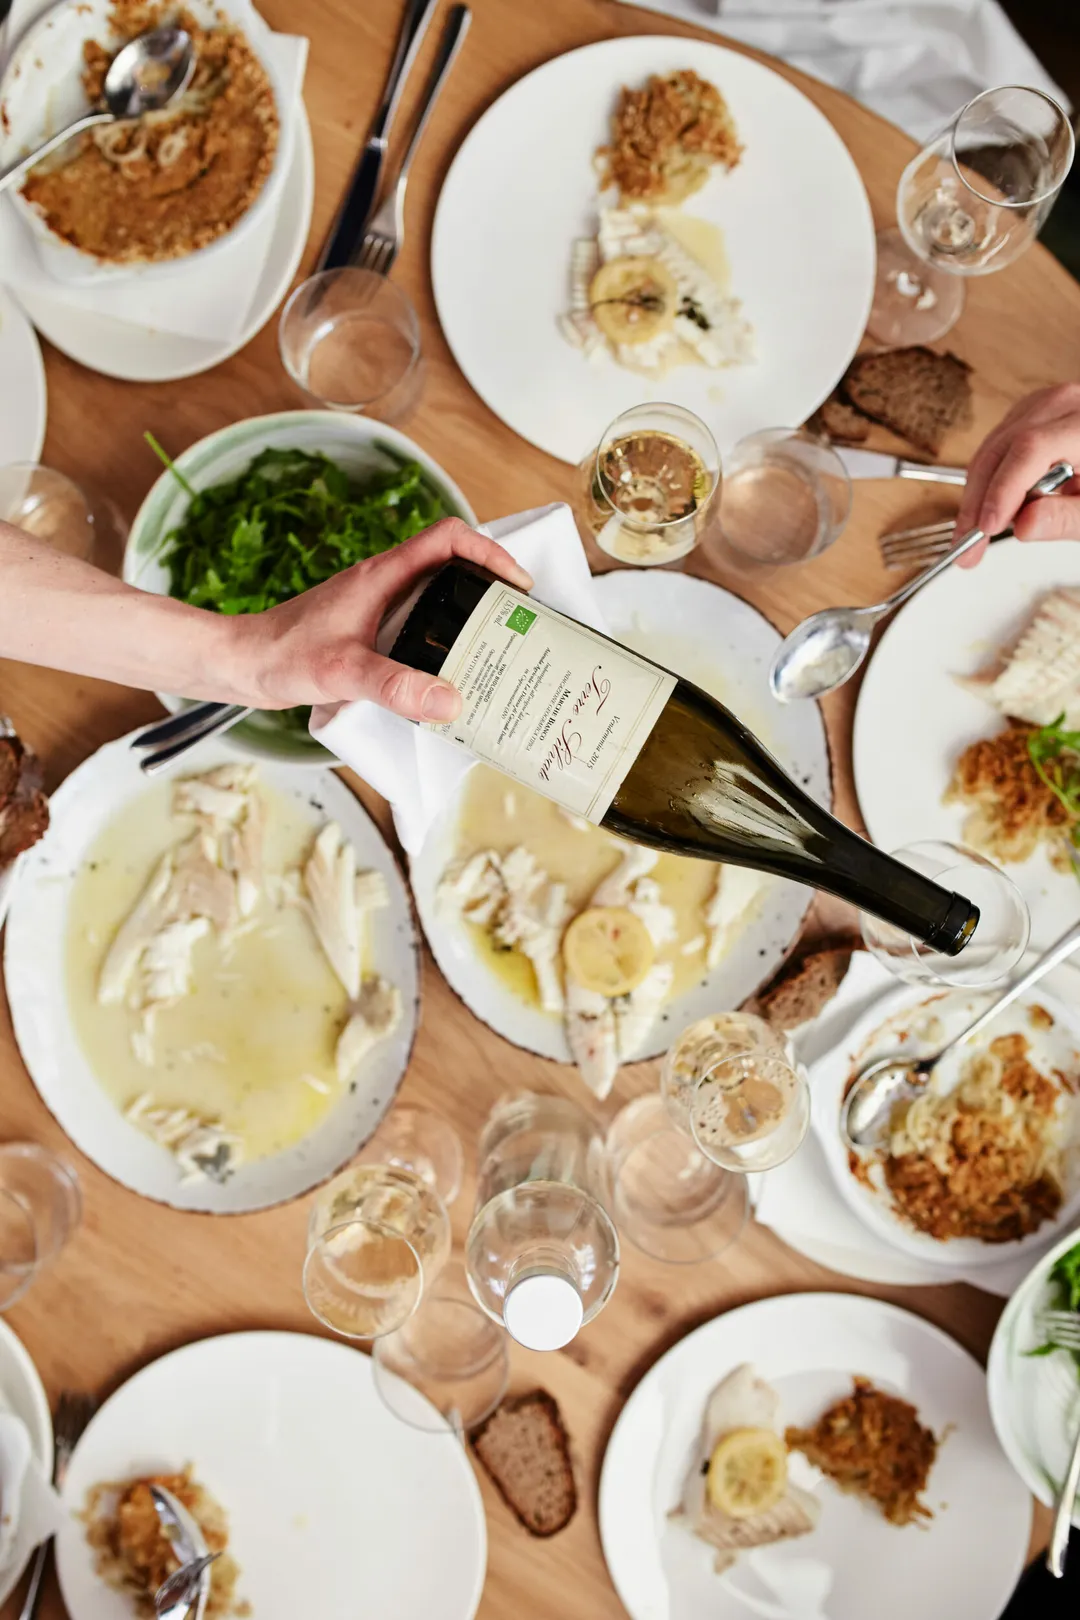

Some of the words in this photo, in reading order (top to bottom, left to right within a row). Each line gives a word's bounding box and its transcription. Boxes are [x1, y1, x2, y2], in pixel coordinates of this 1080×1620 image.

[499, 599, 515, 617] 13,5%
[466, 640, 487, 673] PRODOTTO
[538, 646, 551, 665] Azienda
[462, 672, 470, 680] IN
[496, 662, 506, 676] VINO
[526, 663, 541, 684] Agricola
[456, 679, 467, 692] ITAL
[482, 675, 500, 702] BIOLOGICO
[523, 683, 530, 691] La
[549, 669, 571, 704] INDICAZIONE
[571, 665, 611, 715] Terre
[551, 688, 571, 717] MARCHE
[532, 703, 553, 736] GEOGRAFICA
[538, 717, 555, 741] BIANCO
[525, 736, 536, 751] TIPICA
[594, 714, 620, 752] Vendemmia
[537, 719, 581, 781] Silvate
[585, 751, 600, 769] 2015
